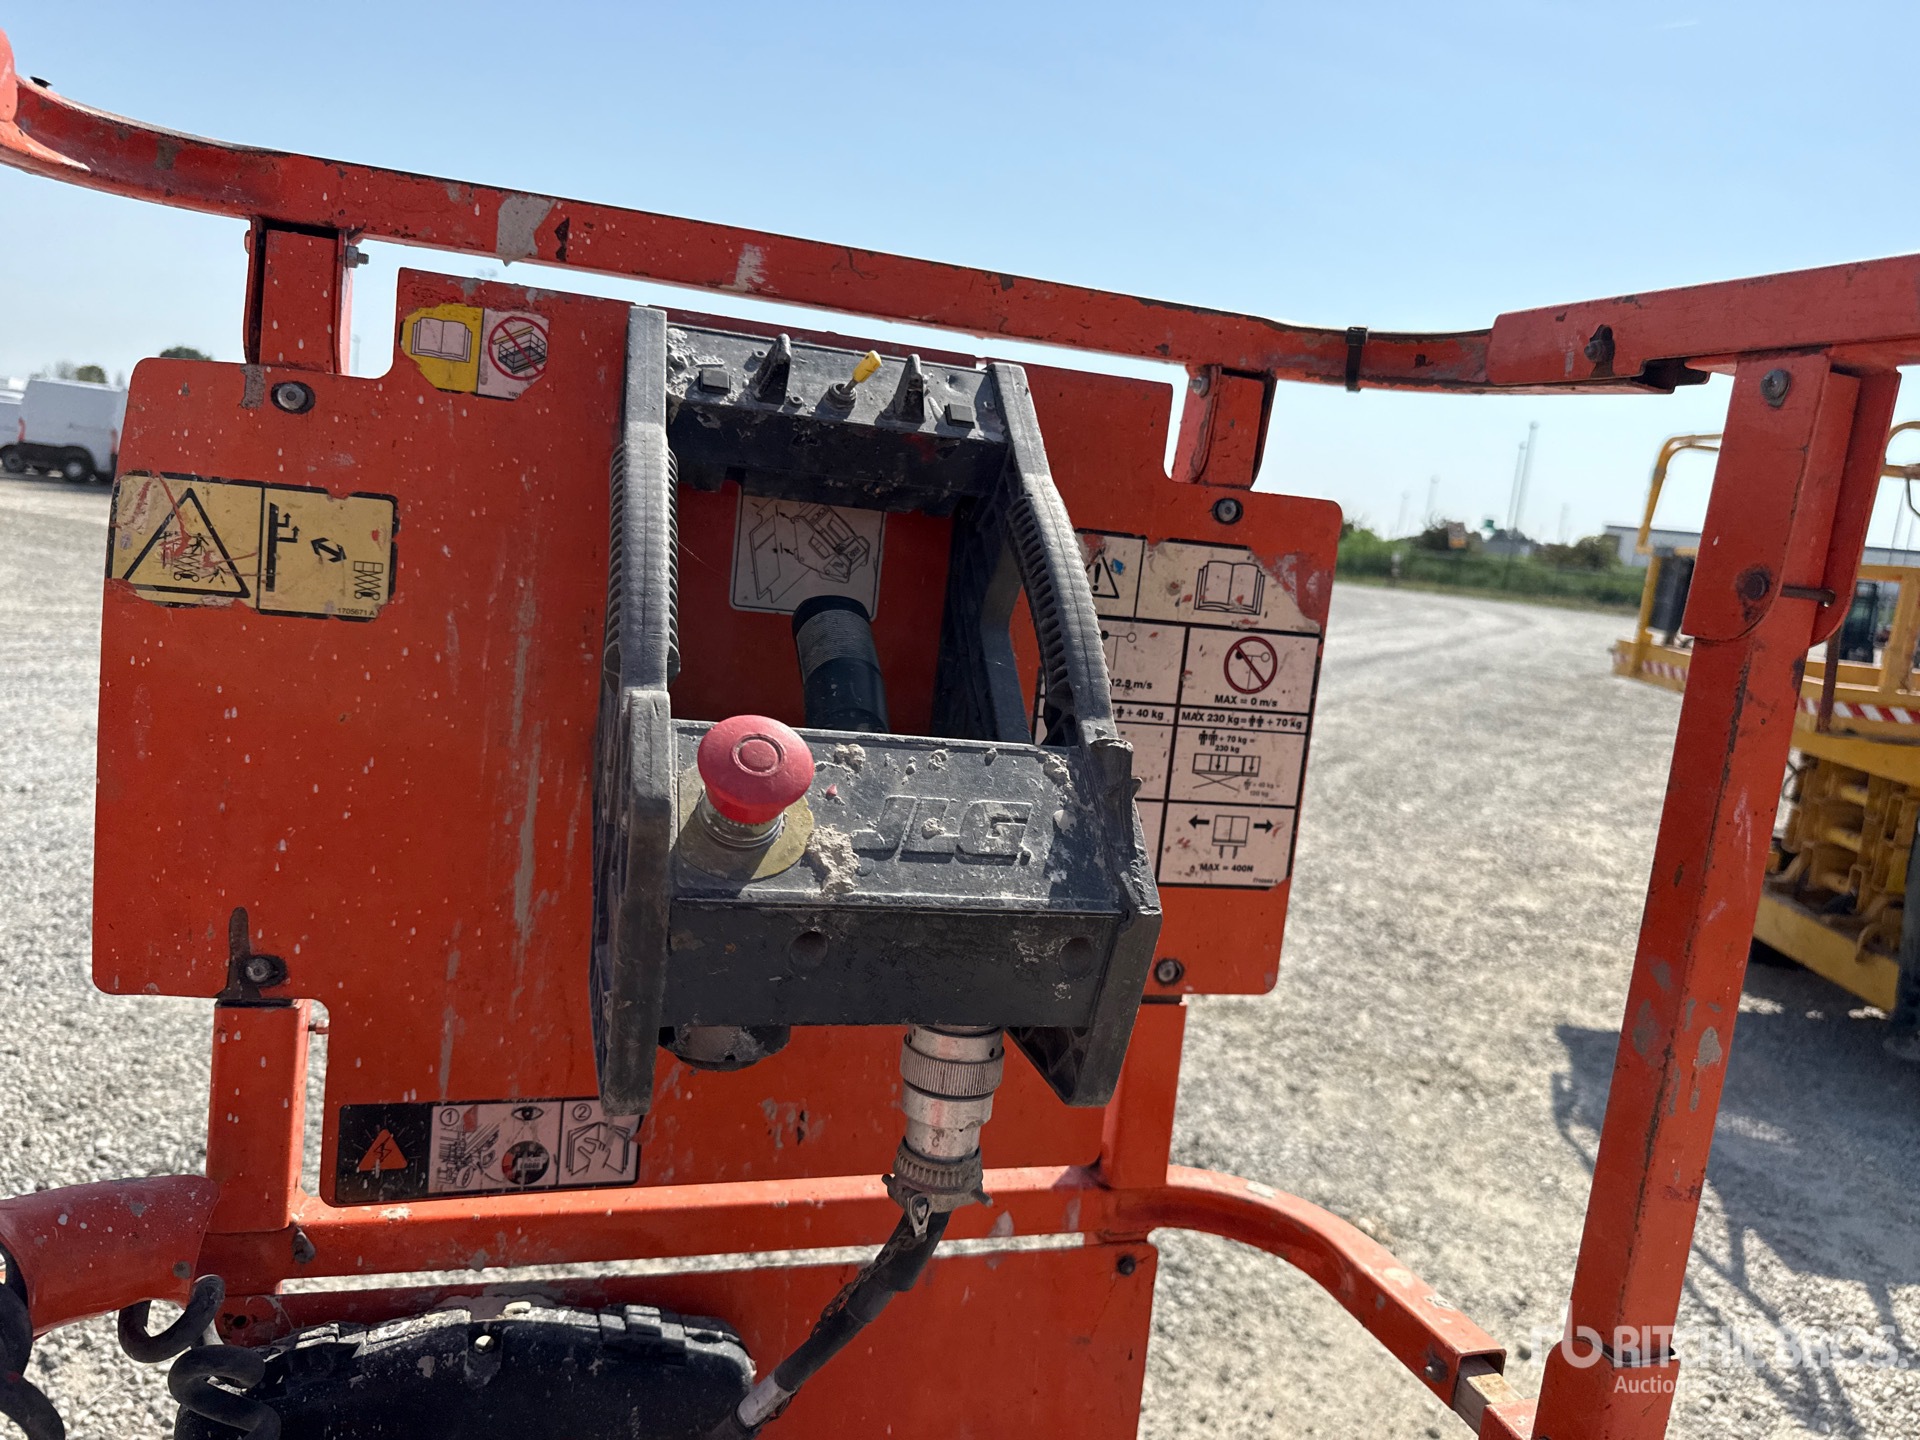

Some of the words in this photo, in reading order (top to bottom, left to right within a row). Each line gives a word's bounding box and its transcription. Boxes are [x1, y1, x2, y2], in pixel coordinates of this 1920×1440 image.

[337, 607, 368, 615] 1705671
[1133, 680, 1153, 690] m/s
[1214, 694, 1238, 705] MAX
[1250, 697, 1257, 706] 0
[1259, 698, 1278, 708] m/s
[1136, 708, 1149, 718] 40
[1151, 709, 1164, 721] kg
[1181, 711, 1205, 722] MAX
[1206, 713, 1226, 723] 230
[1276, 718, 1288, 727] 70
[1289, 718, 1303, 730] kg
[1226, 735, 1237, 743] 70
[1237, 735, 1248, 746] kg
[1215, 744, 1229, 752] 230
[1230, 745, 1240, 754] kg
[853, 795, 1033, 864] JLG
[1200, 863, 1220, 872] MAX
[1231, 864, 1254, 872] 400N
